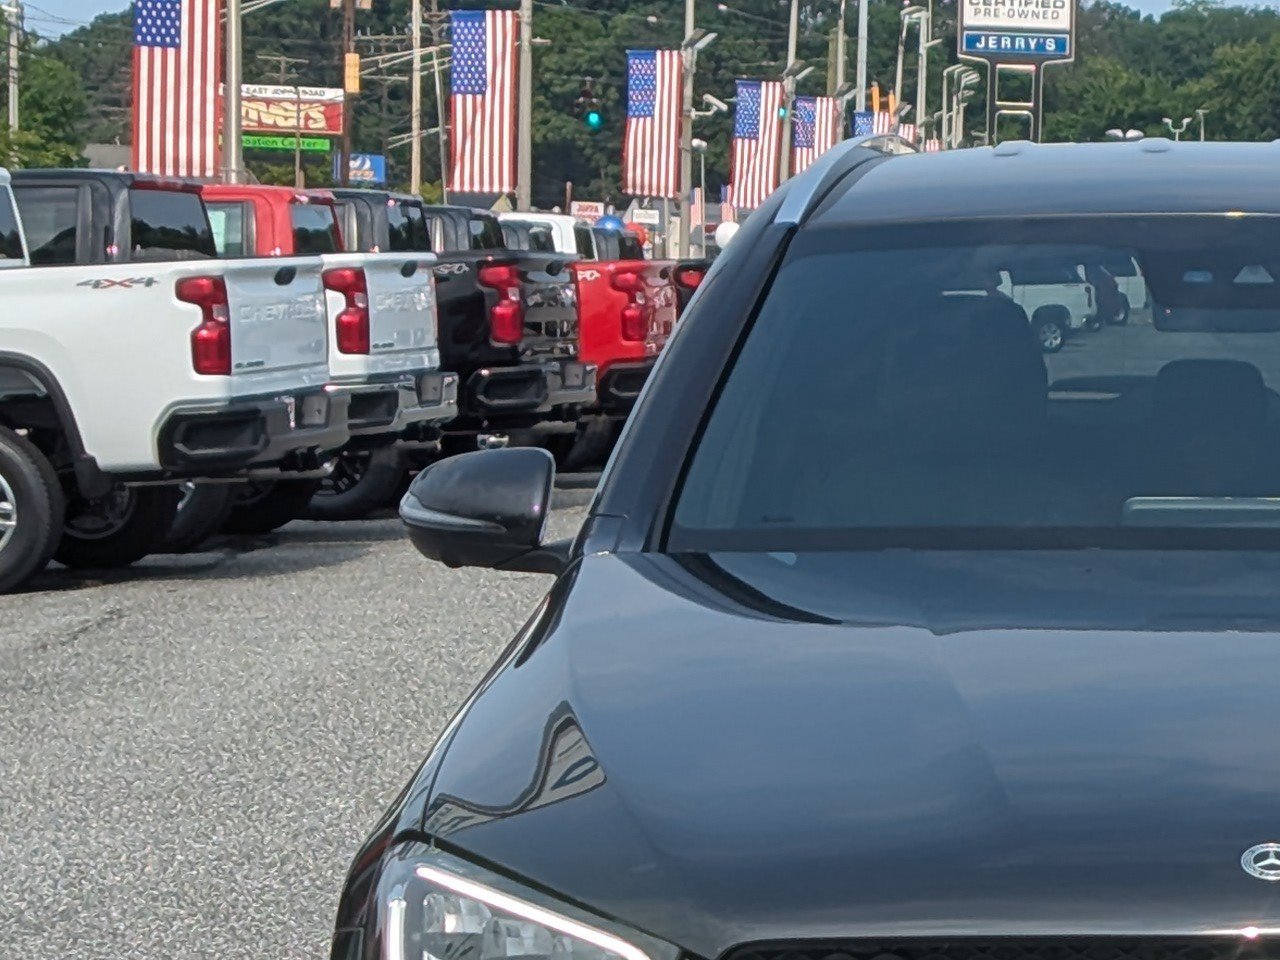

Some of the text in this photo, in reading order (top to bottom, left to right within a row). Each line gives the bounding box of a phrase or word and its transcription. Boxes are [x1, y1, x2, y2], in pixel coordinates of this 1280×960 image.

[973, 7, 1060, 20] PRE-OWNED
[976, 36, 1056, 51] JERRY'S
[245, 86, 268, 97] EAST
[281, 138, 318, 148] Ceter
